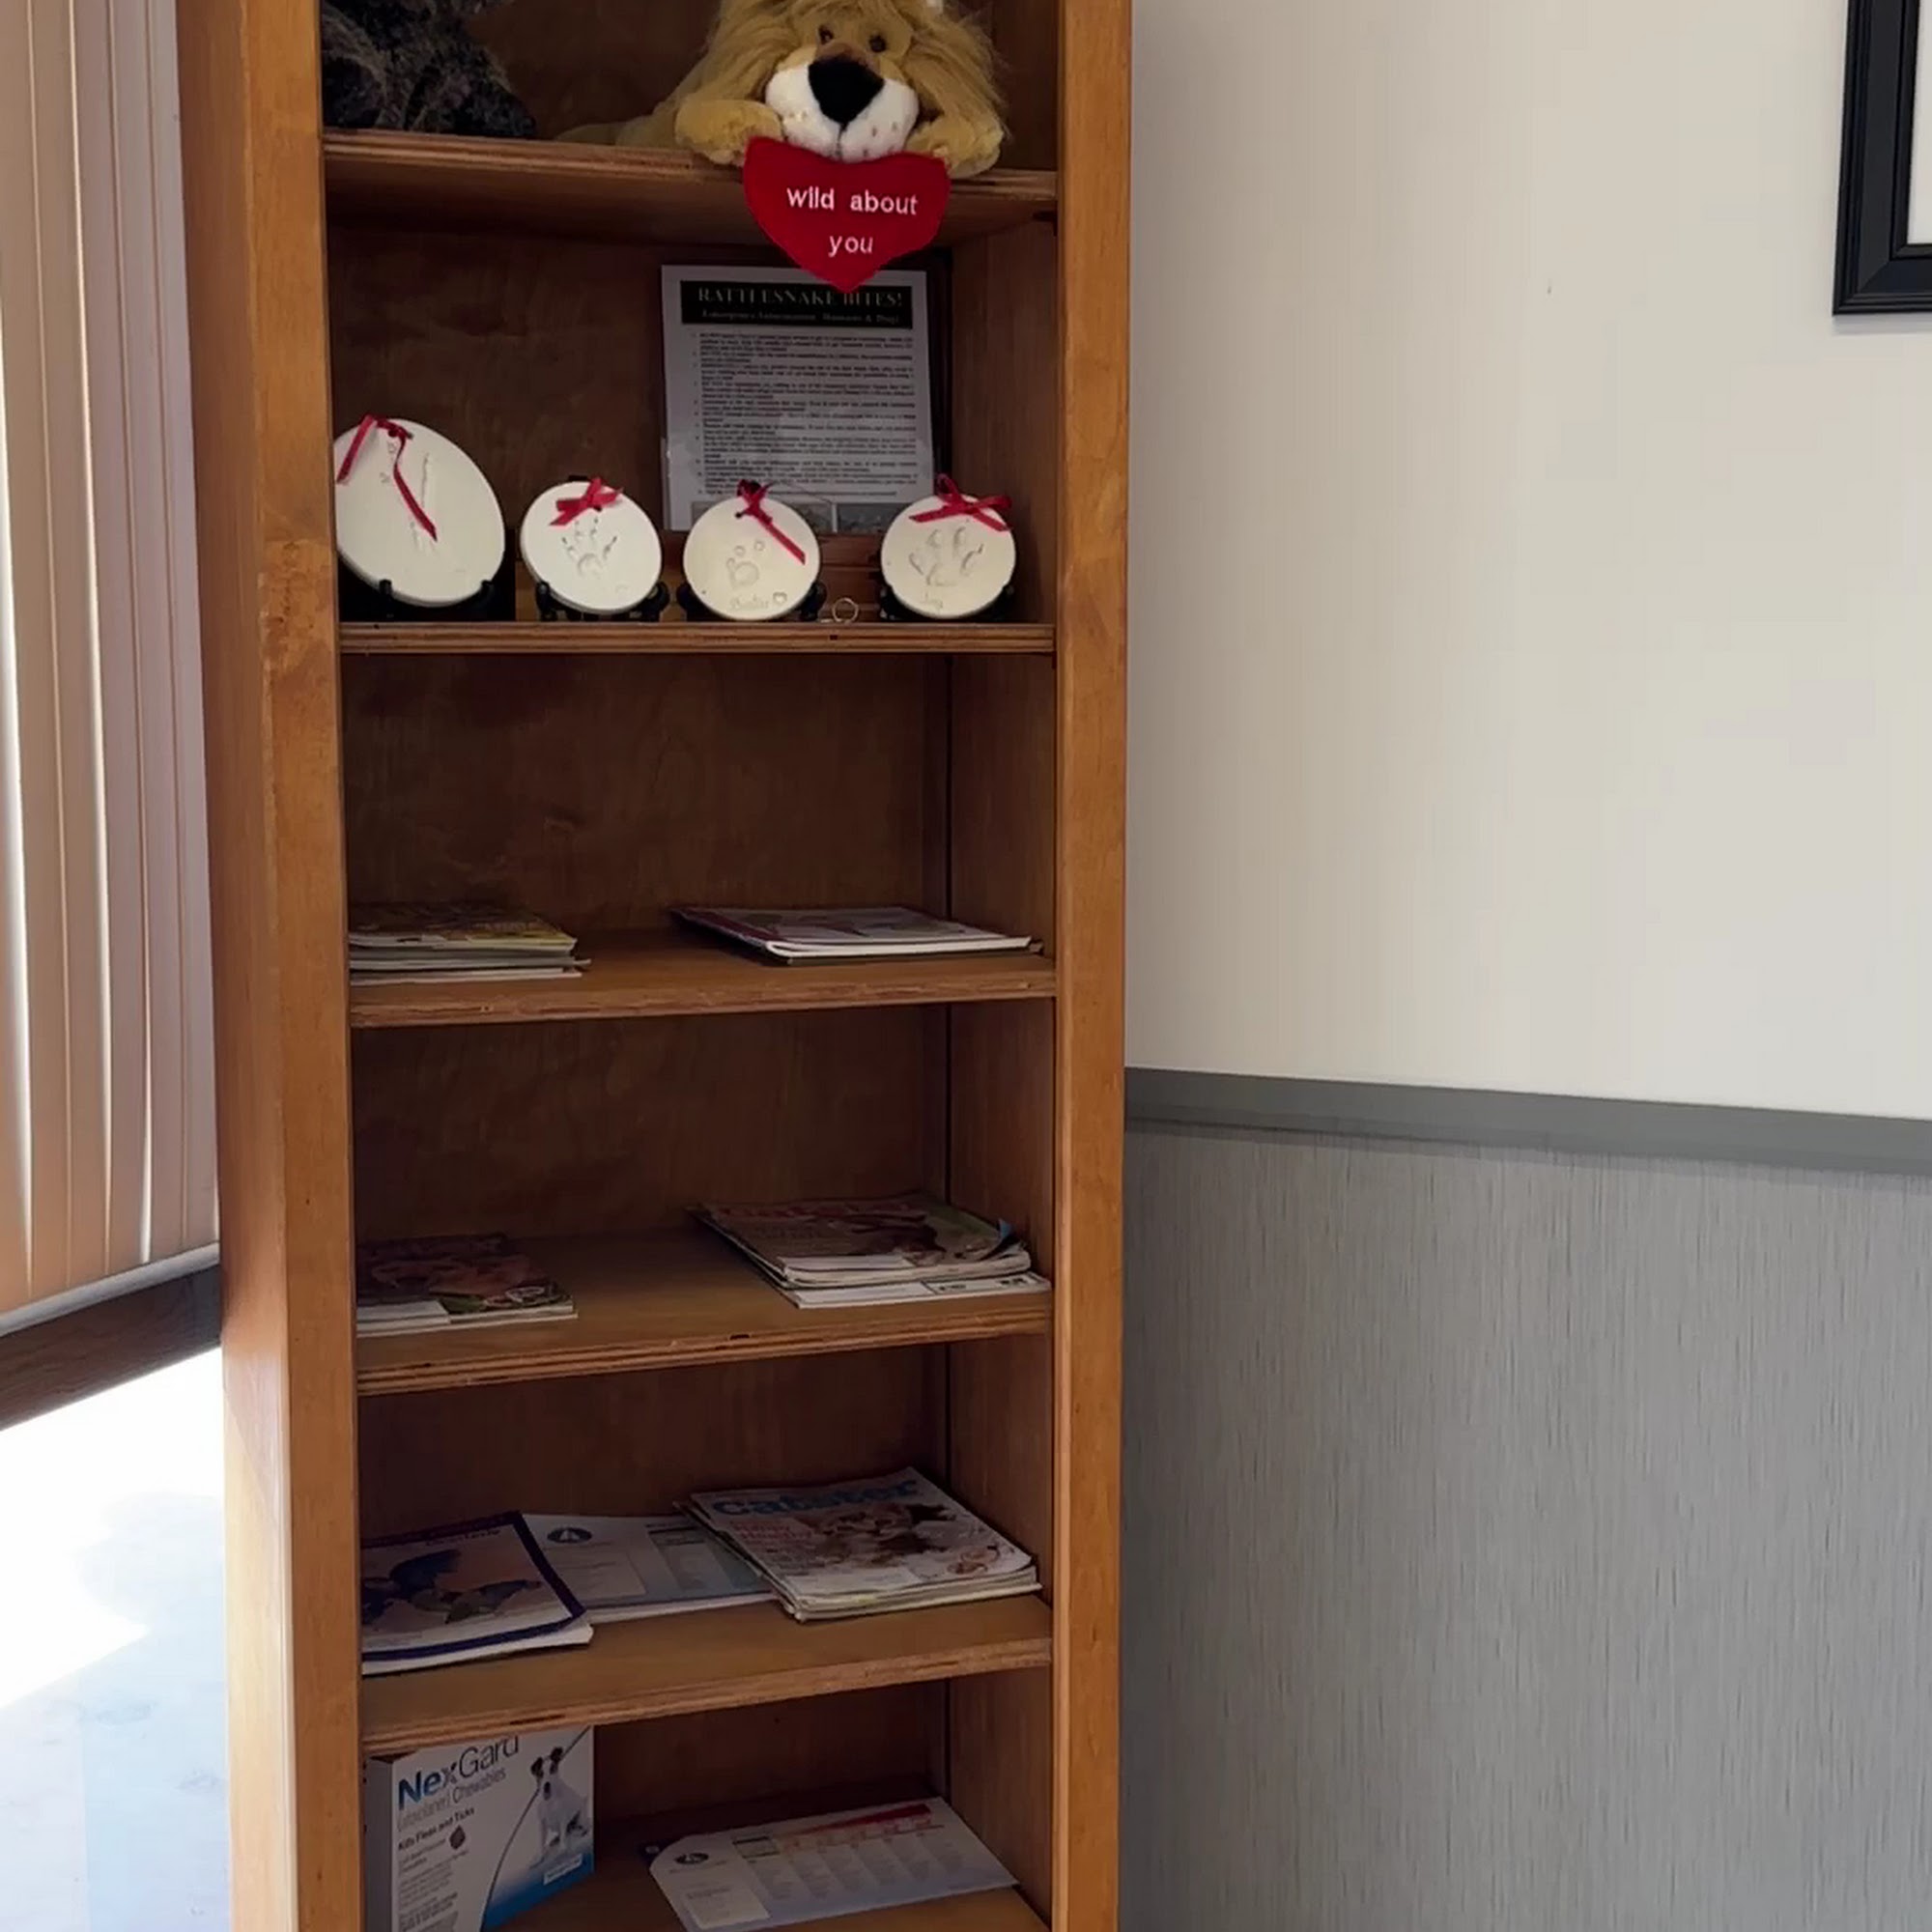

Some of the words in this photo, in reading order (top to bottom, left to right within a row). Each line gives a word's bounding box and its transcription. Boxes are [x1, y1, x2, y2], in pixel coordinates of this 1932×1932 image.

[786, 185, 835, 211] wild
[850, 189, 919, 215] about
[828, 235, 874, 258] you
[698, 286, 835, 306] RATTLESNAKE
[398, 1735, 519, 1811] NexGard
